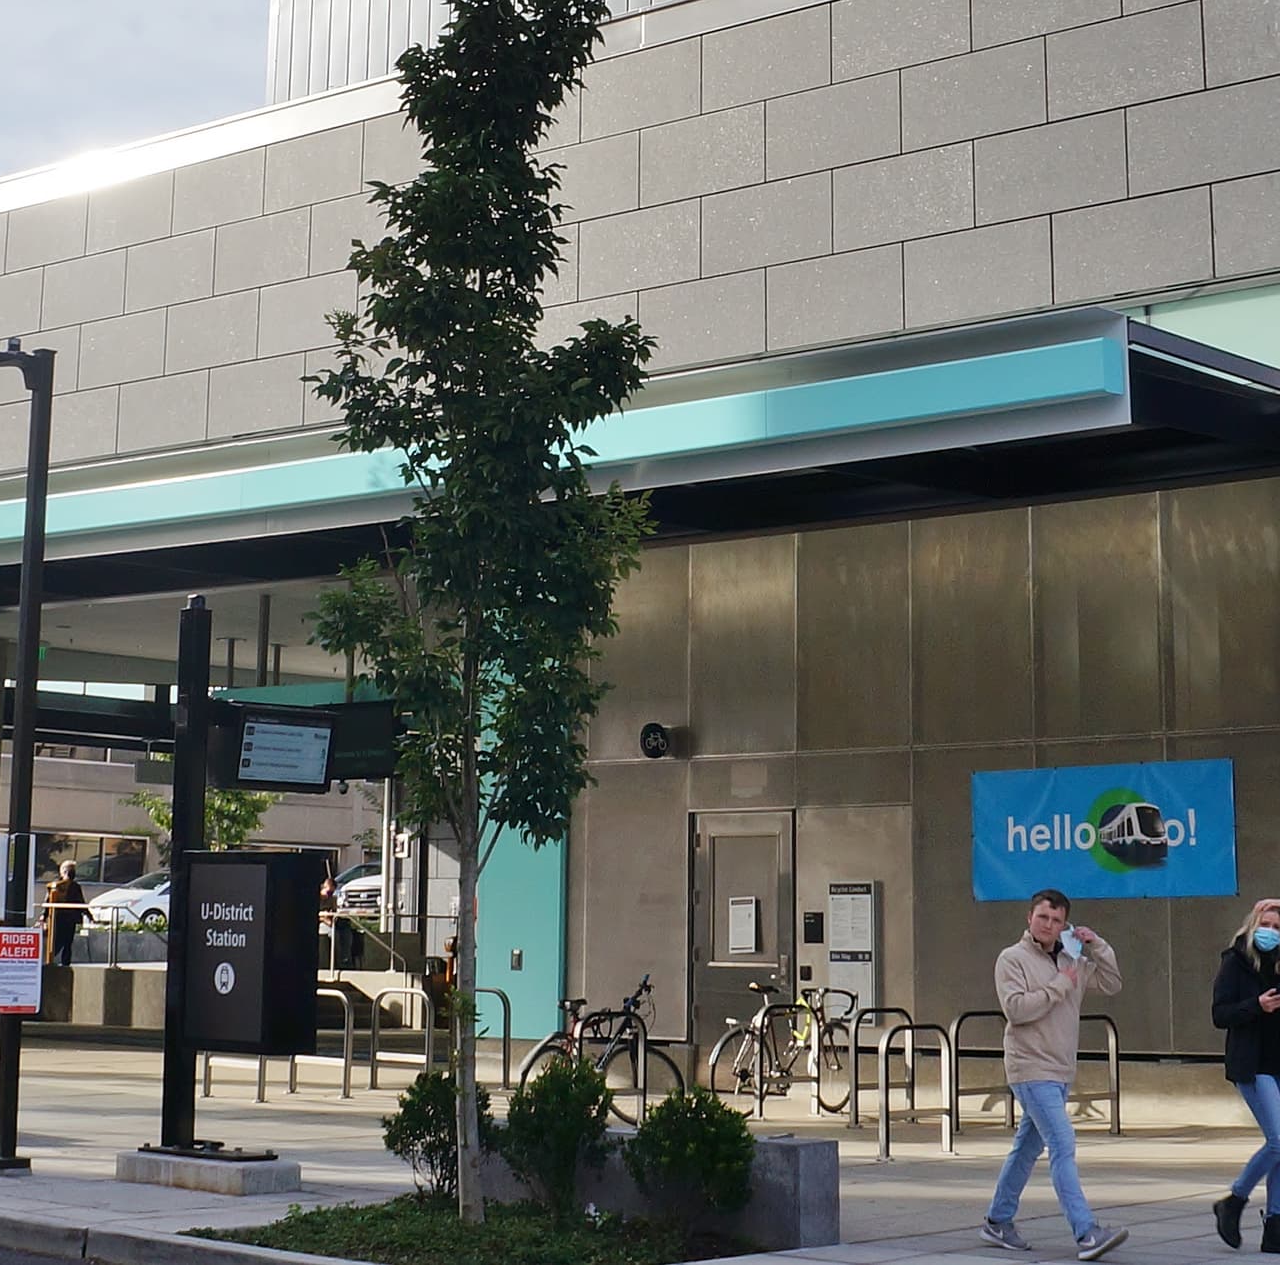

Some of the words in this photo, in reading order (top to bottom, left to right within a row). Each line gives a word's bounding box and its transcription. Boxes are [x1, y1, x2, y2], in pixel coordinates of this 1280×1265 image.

[200, 902, 254, 922] U-District
[1, 934, 34, 944] RIDER
[205, 928, 246, 947] Station
[0, 947, 36, 957] ALERT
